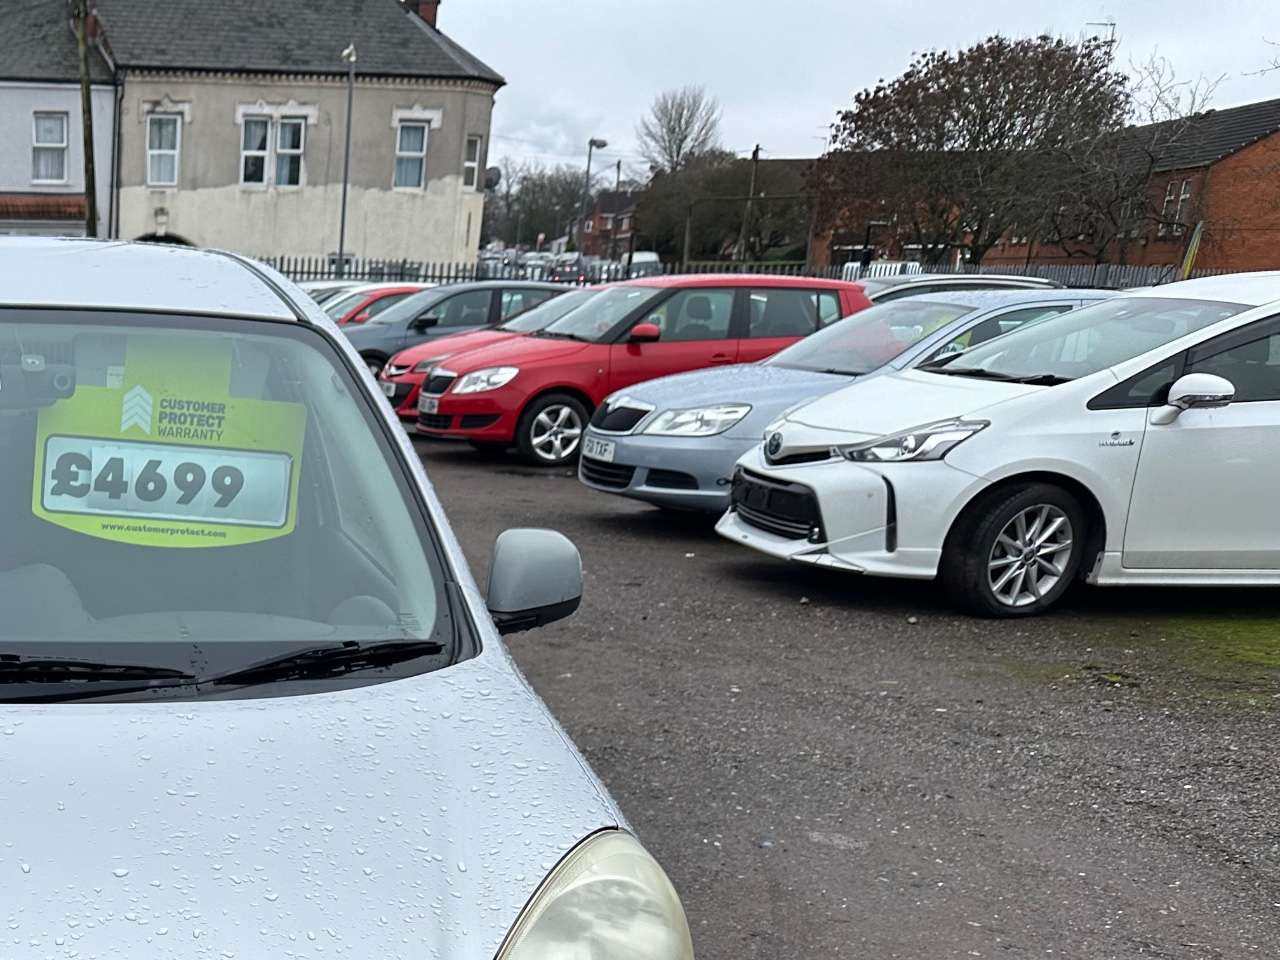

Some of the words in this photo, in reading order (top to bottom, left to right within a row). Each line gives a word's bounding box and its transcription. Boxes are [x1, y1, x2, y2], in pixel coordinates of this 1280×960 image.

[160, 398, 226, 414] CUSTOMER
[158, 410, 225, 429] PROTECT
[158, 425, 224, 441] WARRANTY
[50, 452, 244, 508] £4699
[101, 522, 226, 538] www.customerprotect.com
